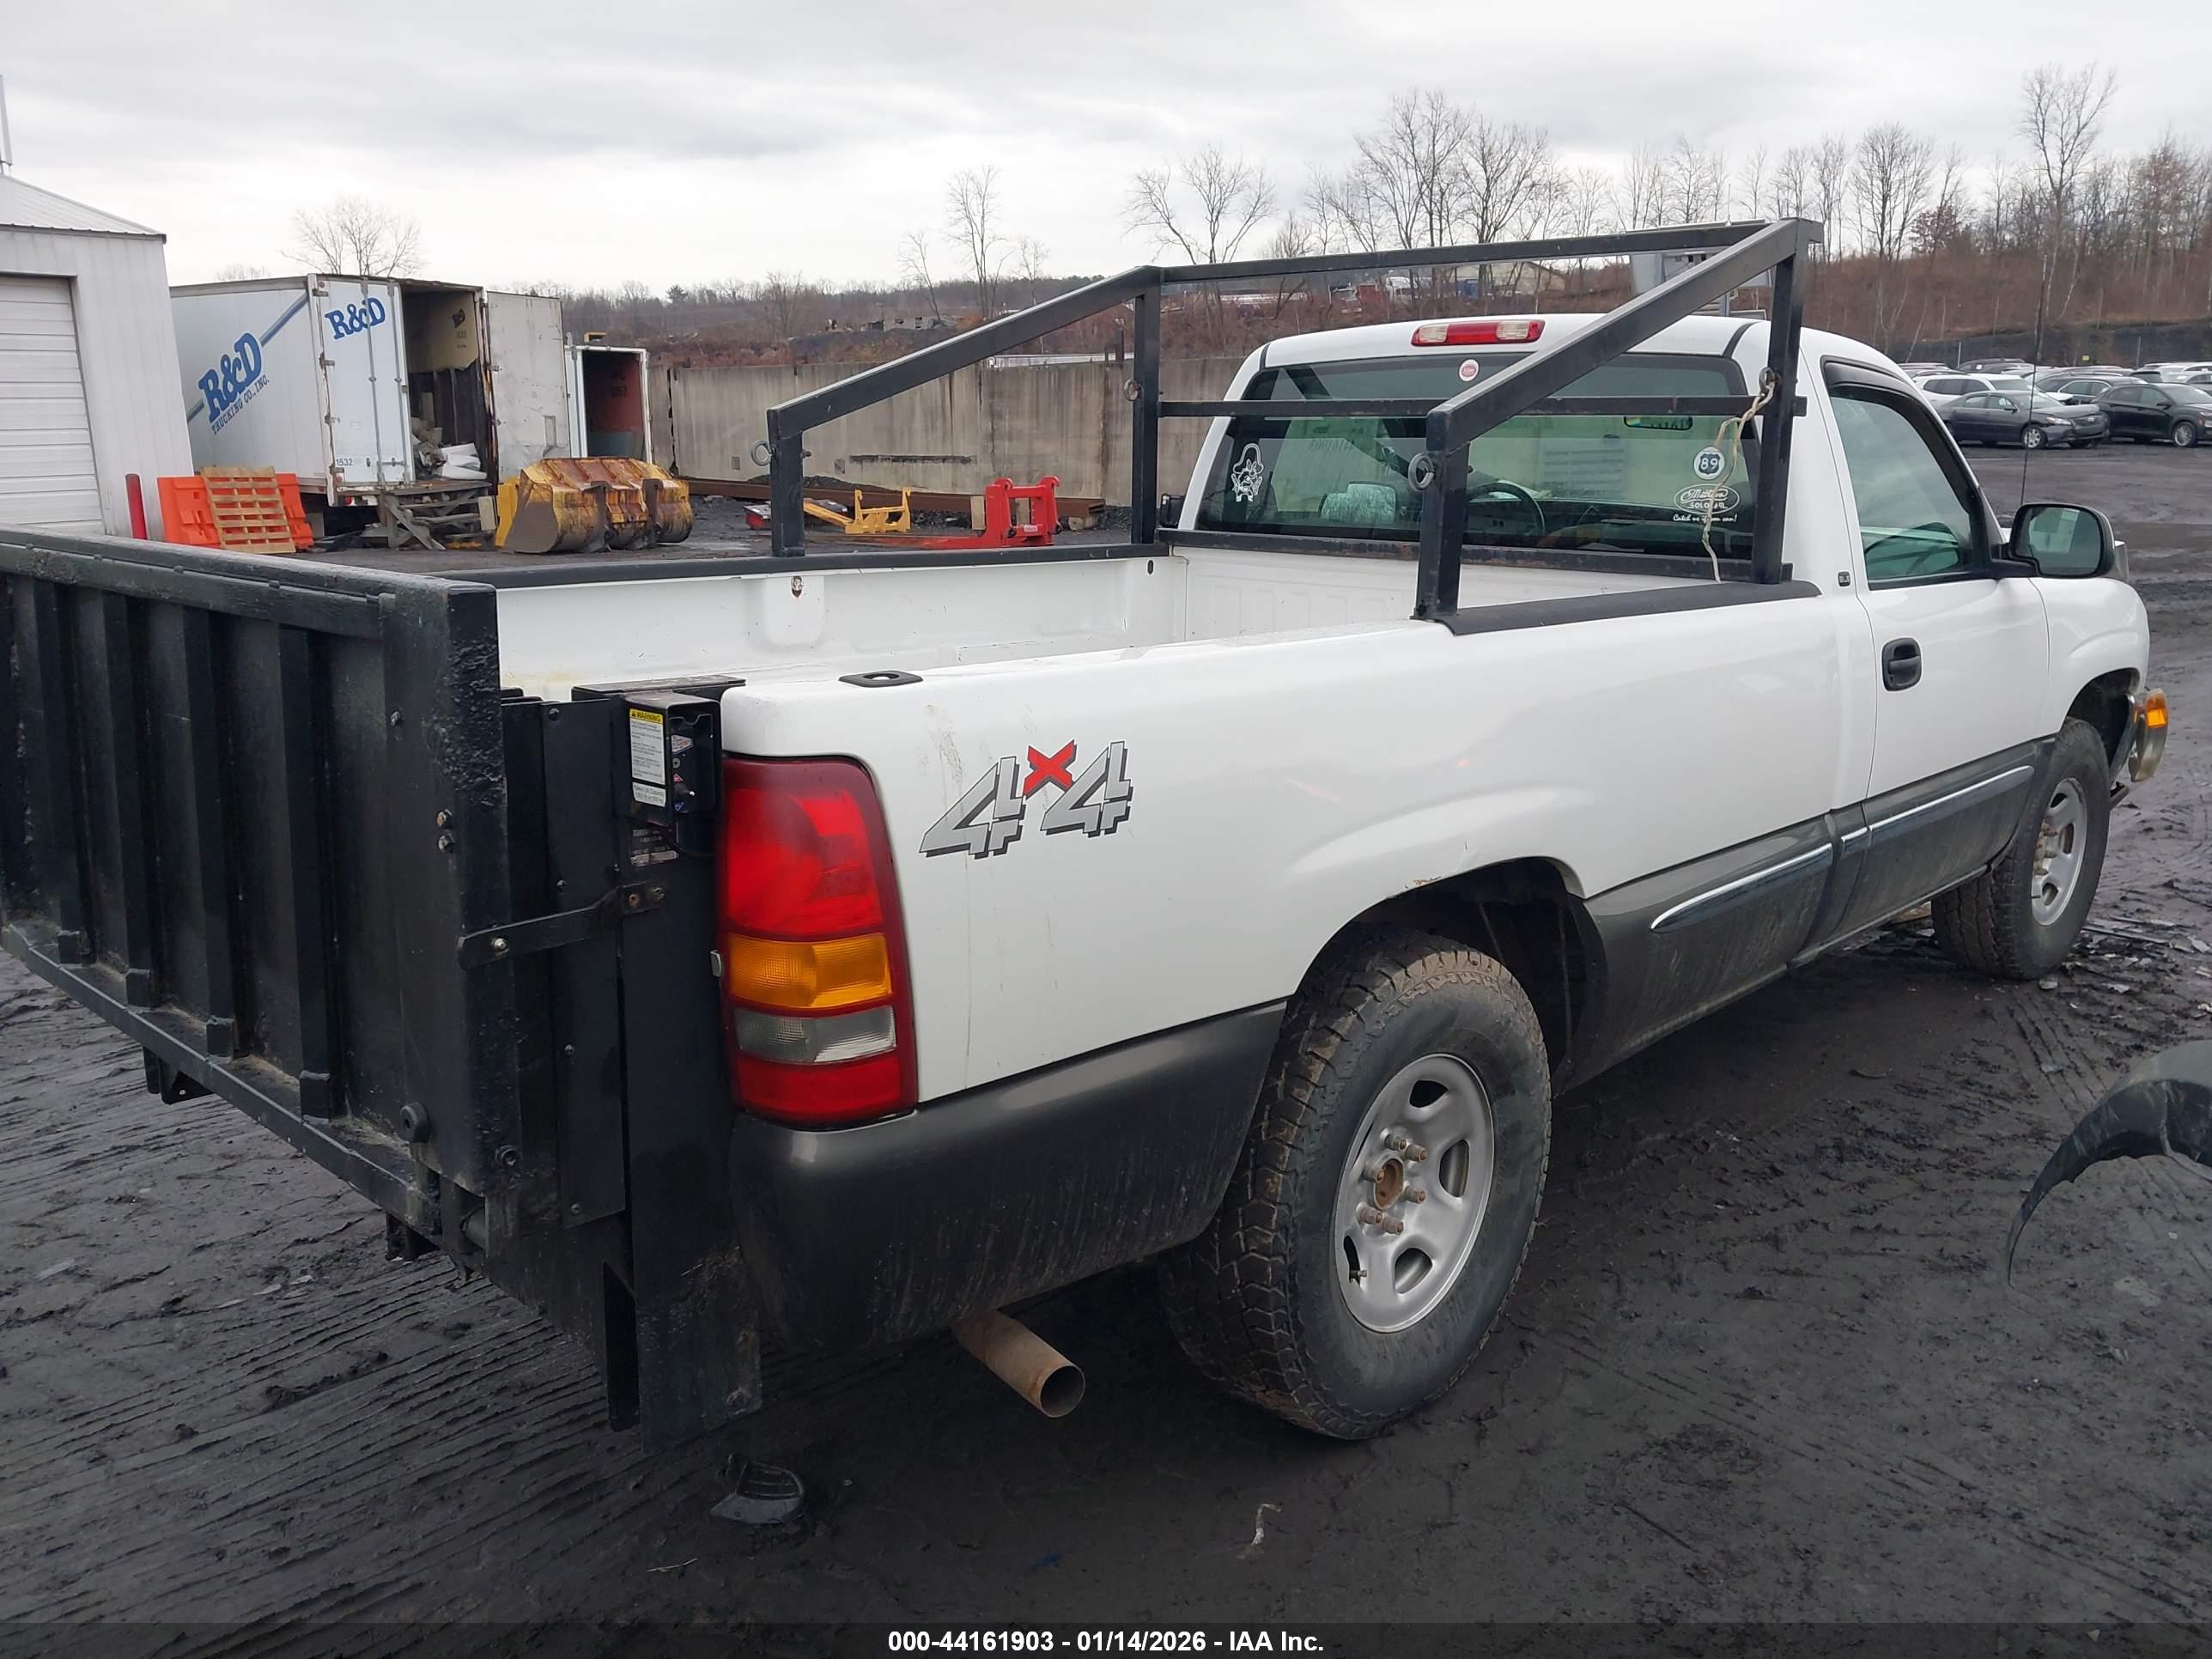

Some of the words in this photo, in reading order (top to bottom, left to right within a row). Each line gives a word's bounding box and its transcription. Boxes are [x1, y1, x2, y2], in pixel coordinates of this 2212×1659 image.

[325, 297, 386, 339] R&D
[198, 332, 262, 423] R&D
[211, 398, 243, 434] TRUCKING
[254, 374, 270, 392] INC.
[336, 458, 353, 467] 1532
[1700, 457, 1718, 471] 89
[1722, 514, 1738, 523] can!
